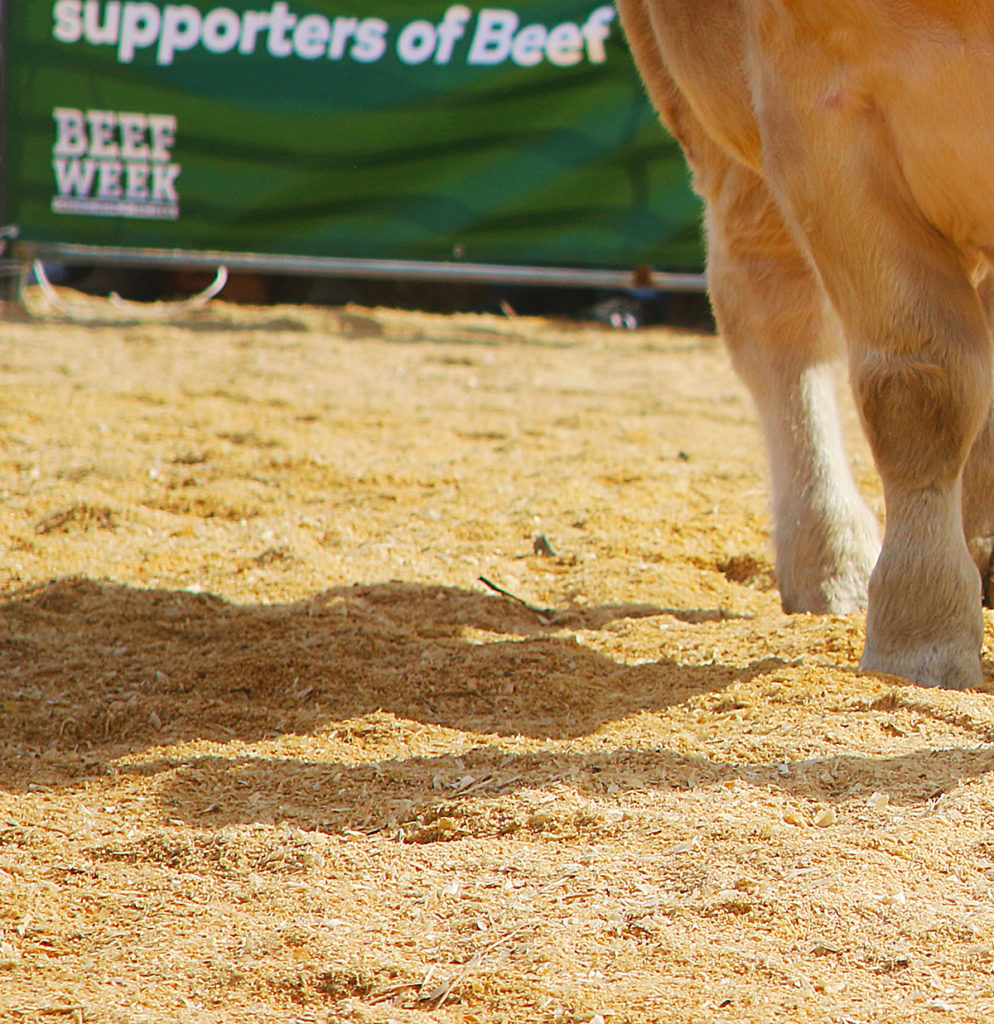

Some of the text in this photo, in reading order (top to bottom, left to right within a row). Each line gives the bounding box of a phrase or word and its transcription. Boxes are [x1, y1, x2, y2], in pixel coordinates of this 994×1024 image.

[396, 5, 471, 65] of
[466, 6, 615, 67] Beef
[52, 107, 177, 162] BEEF
[52, 158, 181, 203] WEEK
